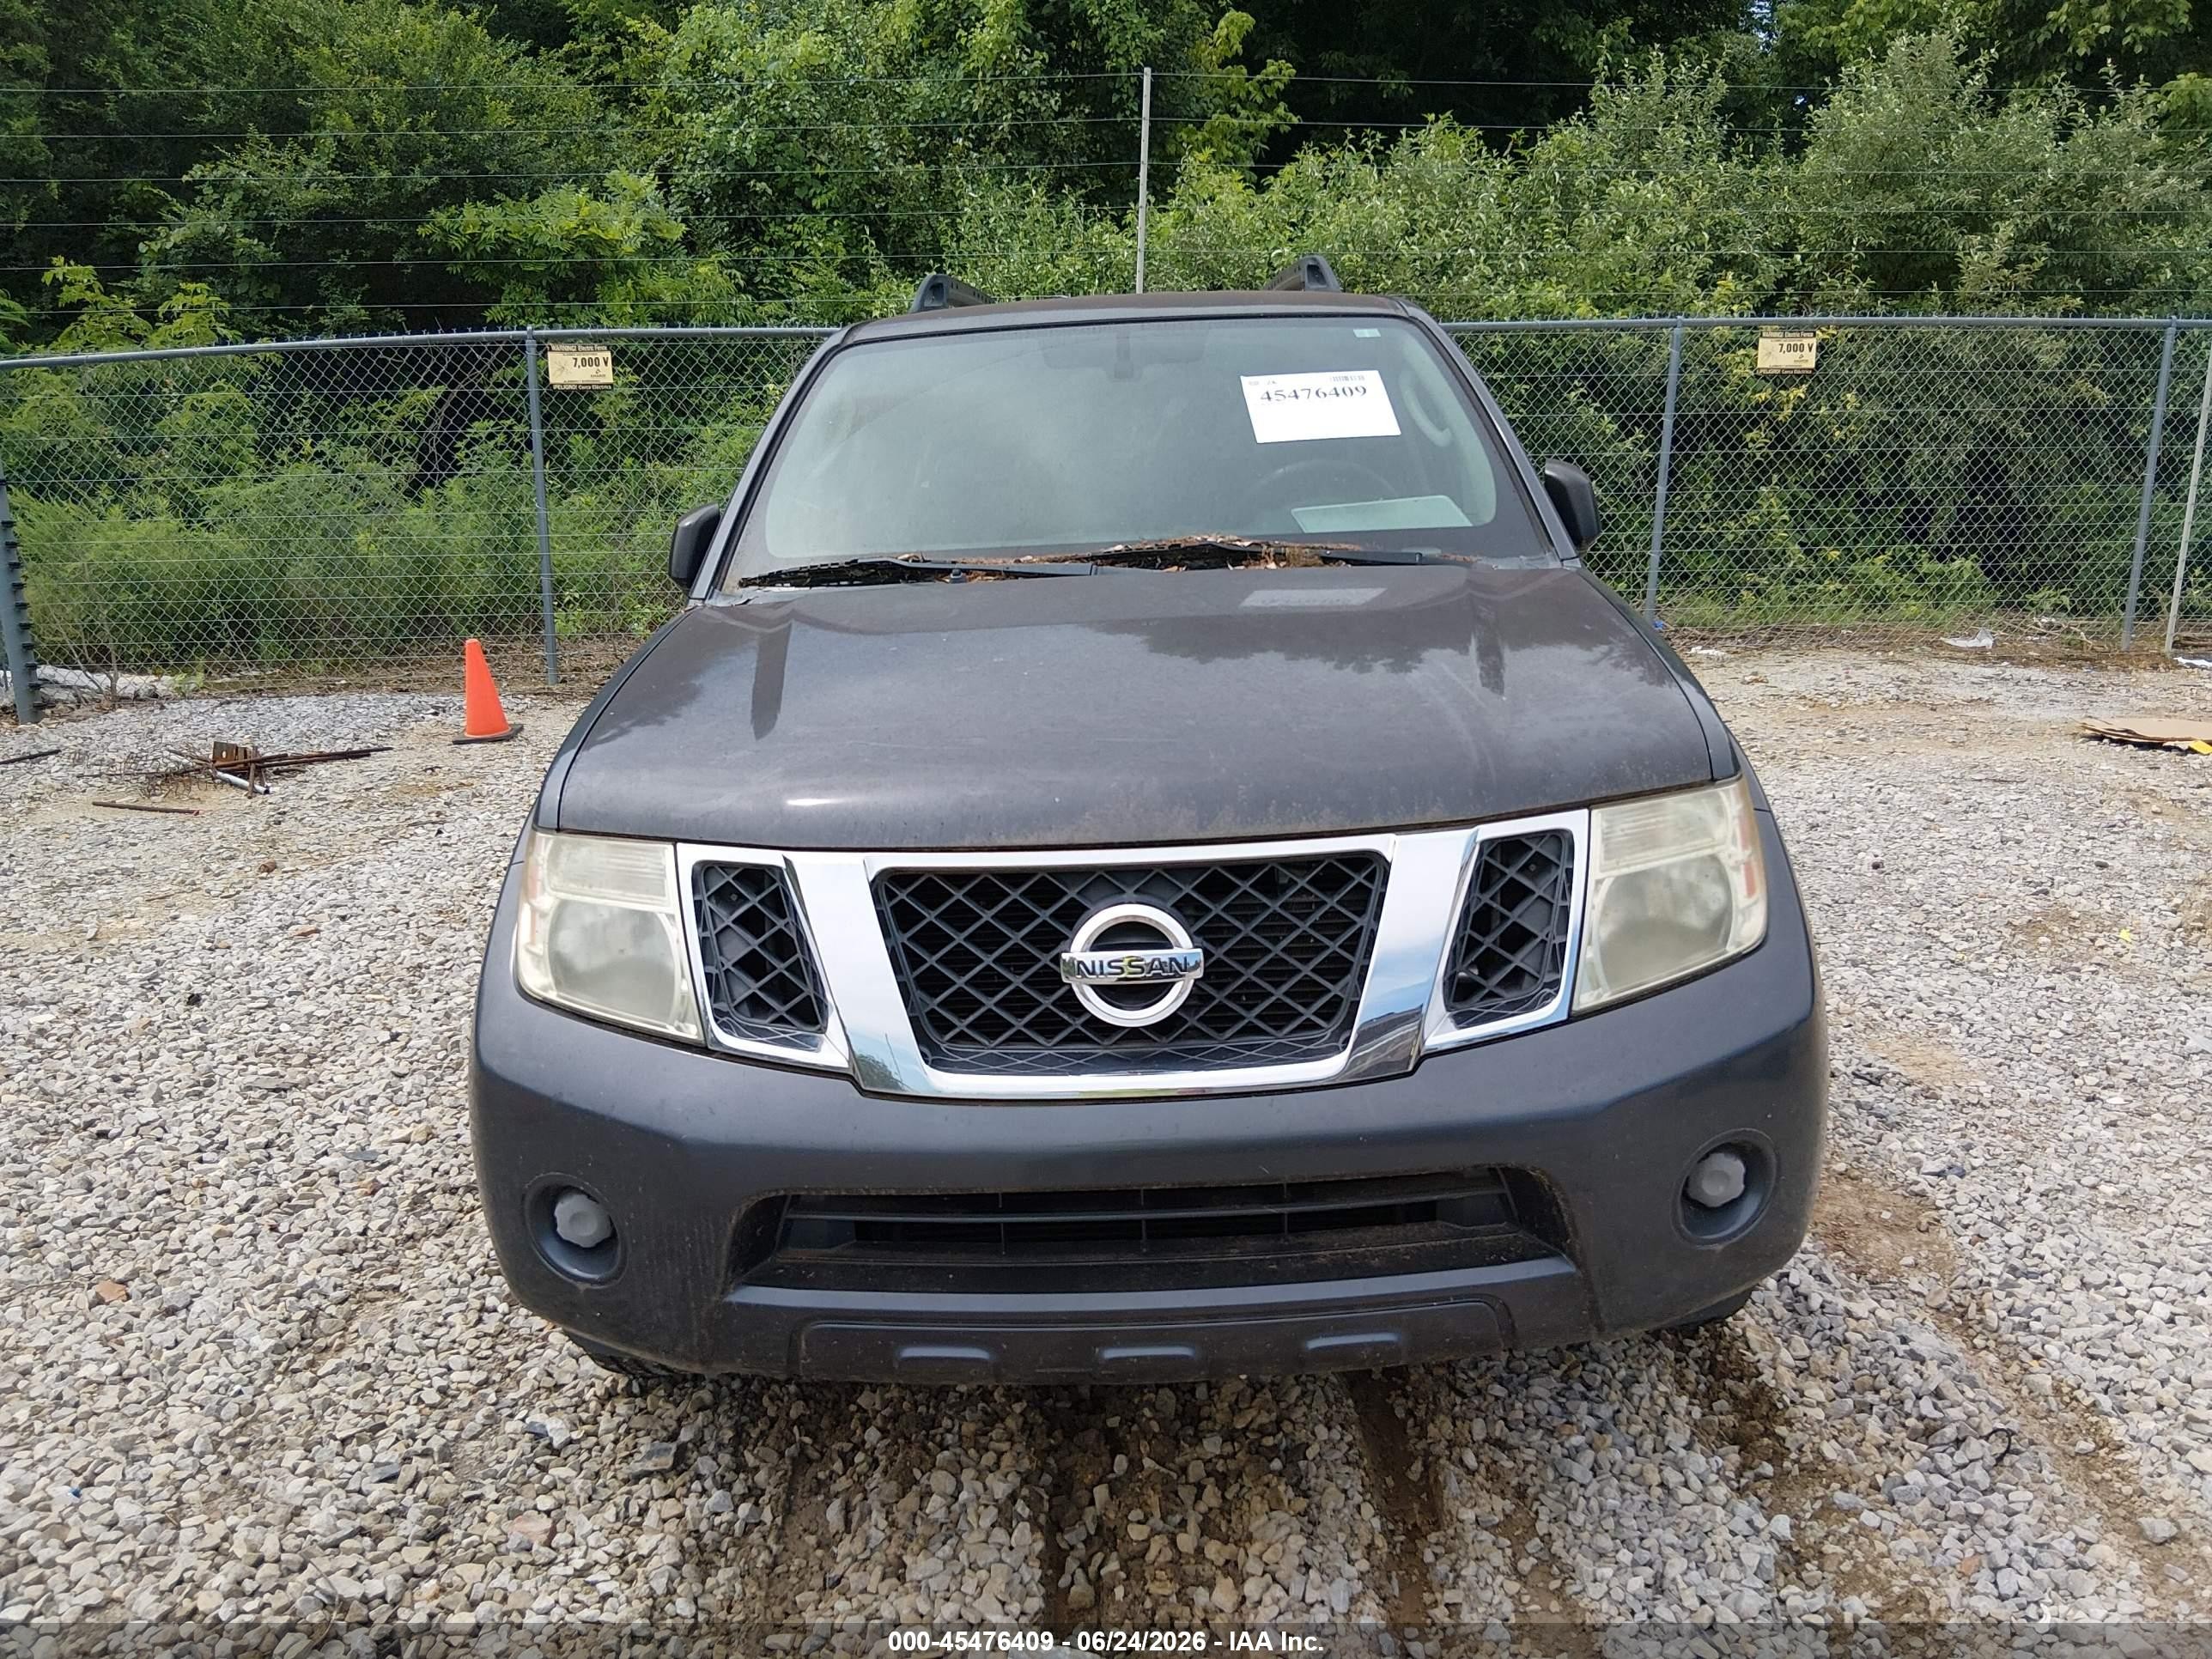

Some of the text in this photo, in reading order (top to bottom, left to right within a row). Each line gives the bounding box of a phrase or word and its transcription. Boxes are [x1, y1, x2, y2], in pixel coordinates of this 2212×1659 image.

[1779, 343, 1814, 354] 7,000 V
[573, 357, 609, 368] 7,000 V
[1260, 385, 1367, 402] 45476409
[1076, 956, 1188, 977] NISSAN
